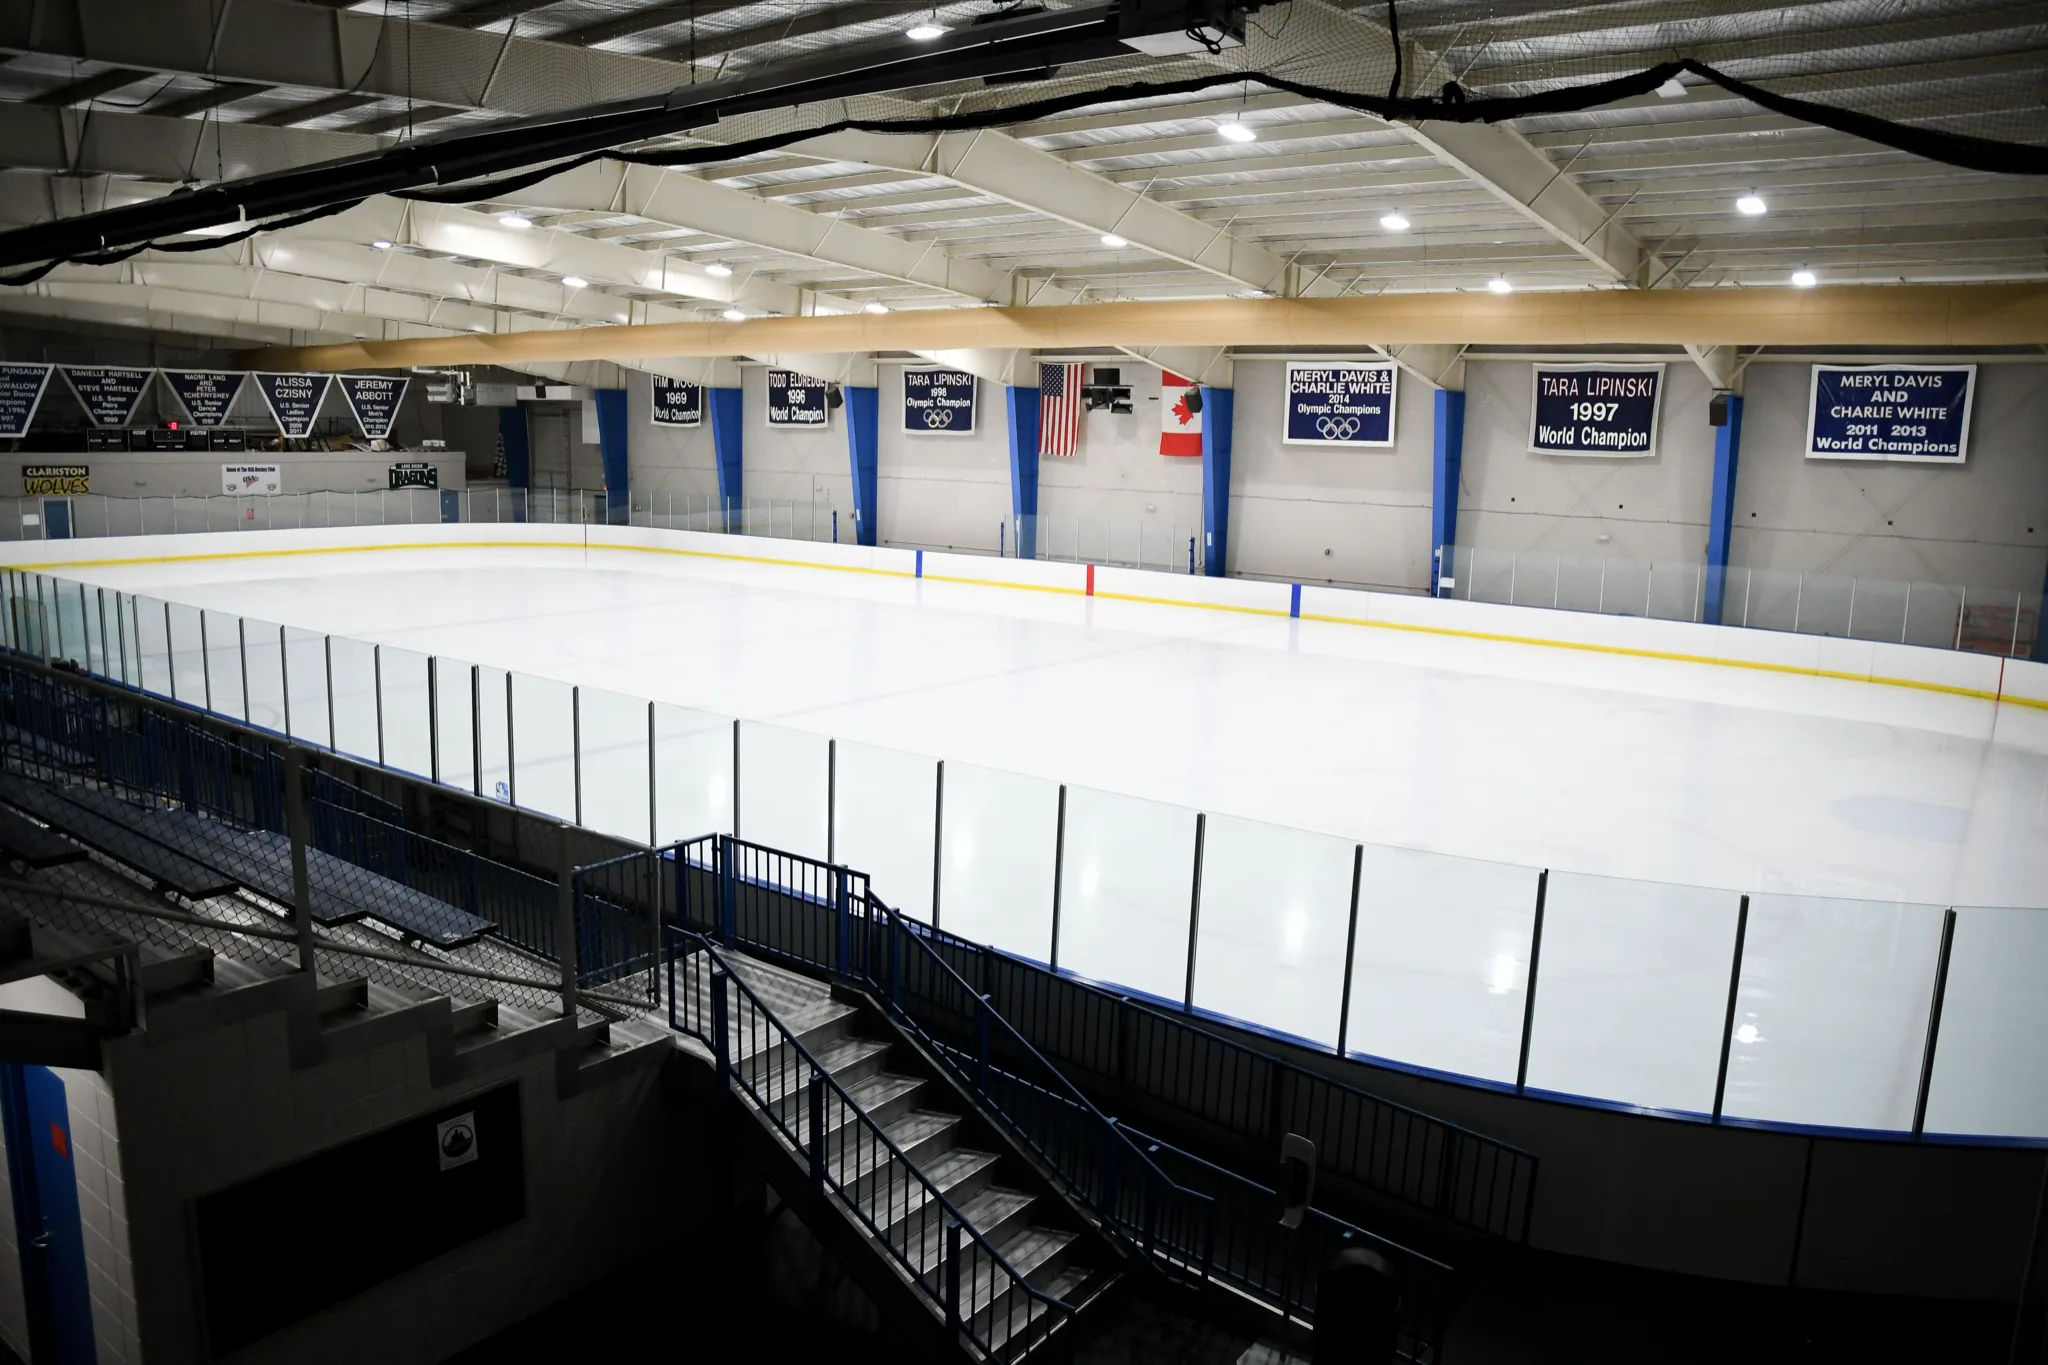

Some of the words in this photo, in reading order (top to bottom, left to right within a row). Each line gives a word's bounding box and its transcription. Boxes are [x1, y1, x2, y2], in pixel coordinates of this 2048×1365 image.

[275, 377, 312, 387] ALISSA
[654, 376, 668, 388] TIM
[770, 374, 786, 387] TODD
[908, 374, 930, 386] TARA
[934, 374, 971, 386] LIPINSKI
[1293, 371, 1336, 382] MERYL
[1340, 371, 1377, 382] DAVIS
[1380, 371, 1389, 382] &
[1840, 375, 1889, 387] MERYL
[1894, 376, 1942, 388] DAVIS
[355, 380, 393, 389] JEREMY
[1291, 382, 1345, 394] CHARLIE
[1349, 383, 1391, 394] WHITE
[1542, 378, 1579, 396] TARA
[1587, 377, 1652, 397] LIPINSKI
[275, 389, 312, 398] CZISNY
[356, 391, 393, 400] ABBOTT
[666, 392, 687, 404] 1969
[787, 389, 806, 404] 1996
[931, 387, 947, 397] 1998
[1870, 391, 1908, 403] AND
[907, 397, 934, 409] Olympic
[937, 397, 970, 409] Champion
[1328, 394, 1350, 404] 2014
[655, 406, 669, 419] World
[671, 408, 700, 422] Champion
[770, 406, 788, 421] World
[791, 406, 823, 424] Champion
[1298, 403, 1331, 415] Olympic
[1334, 404, 1381, 416] Champions
[1570, 402, 1619, 421] 1997
[1830, 406, 1893, 418] CHARLIE
[1897, 407, 1947, 419] WHITE
[1846, 424, 1878, 435] 2011
[1891, 425, 1926, 436] 2013
[1540, 425, 1575, 445] World
[1581, 426, 1646, 450] Champion
[1817, 437, 1862, 450] World
[1868, 438, 1957, 454] Champions
[27, 467, 85, 476] CLARKSTON
[23, 477, 89, 495] WOLVES
